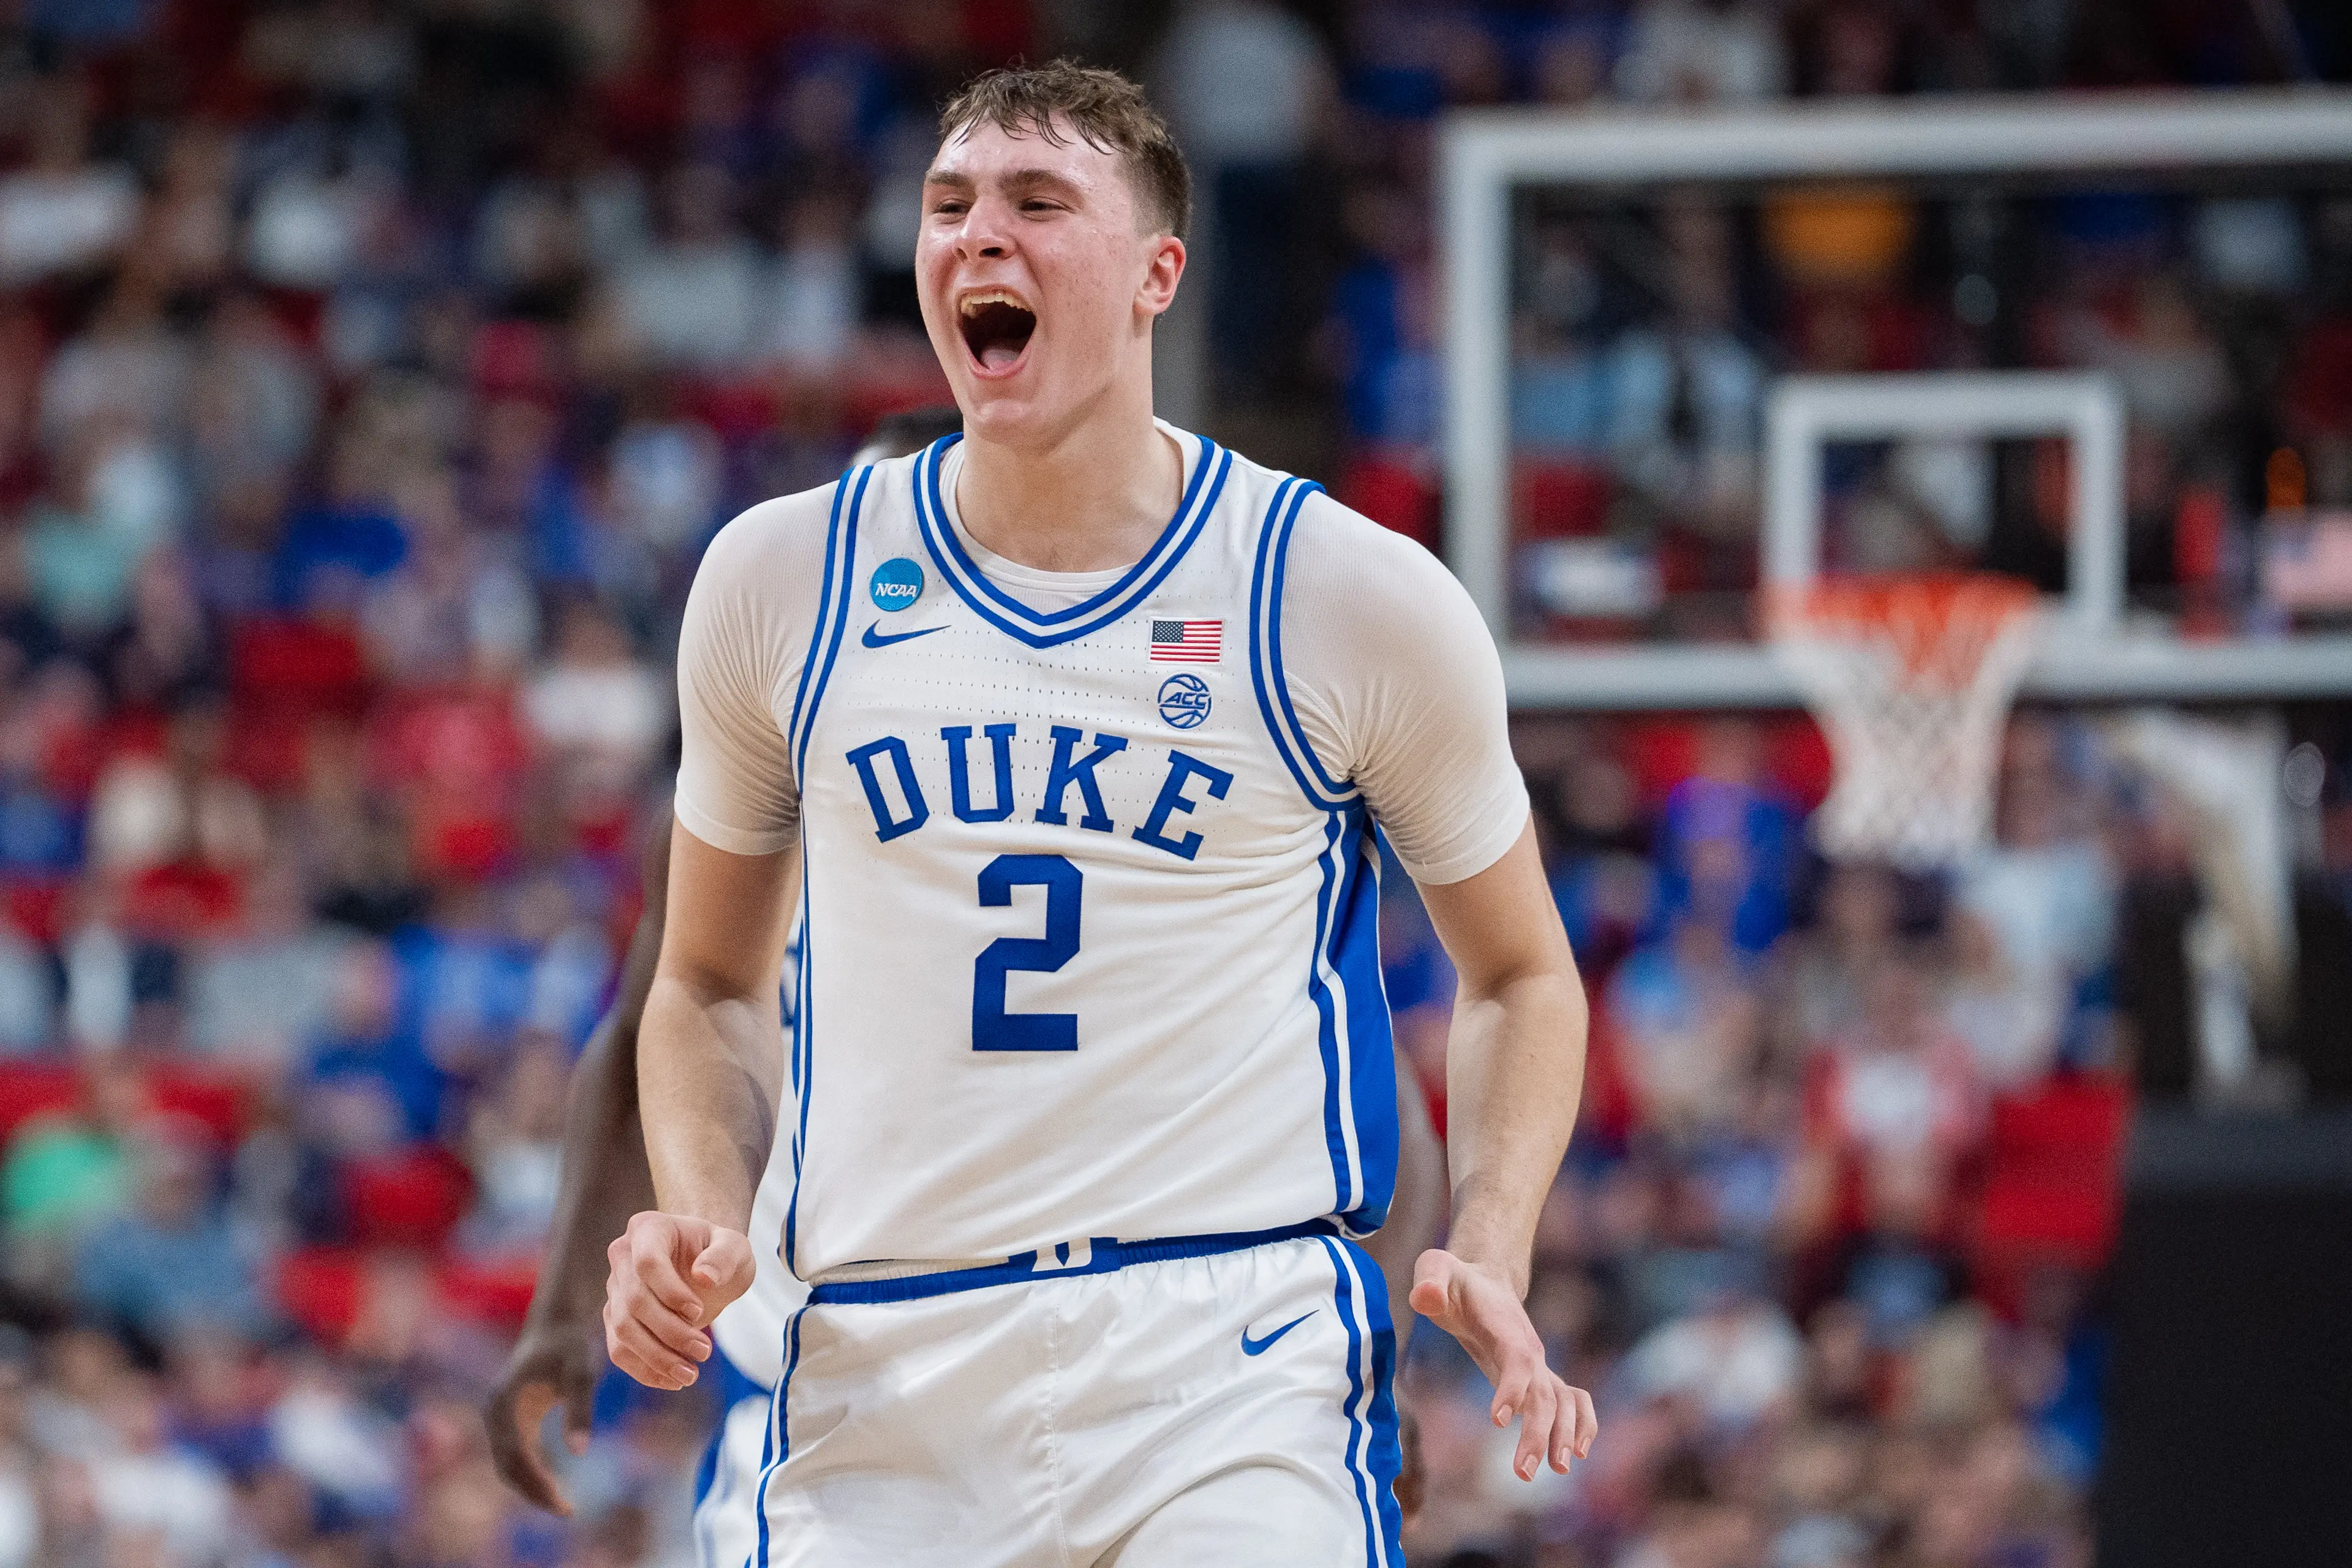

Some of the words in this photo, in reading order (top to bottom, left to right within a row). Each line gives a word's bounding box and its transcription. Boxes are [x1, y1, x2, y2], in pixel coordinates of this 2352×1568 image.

[875, 582, 918, 598] NCAA
[1164, 692, 1209, 706] ACC
[845, 723, 1234, 861] DUKE
[971, 854, 1084, 1051] 2
